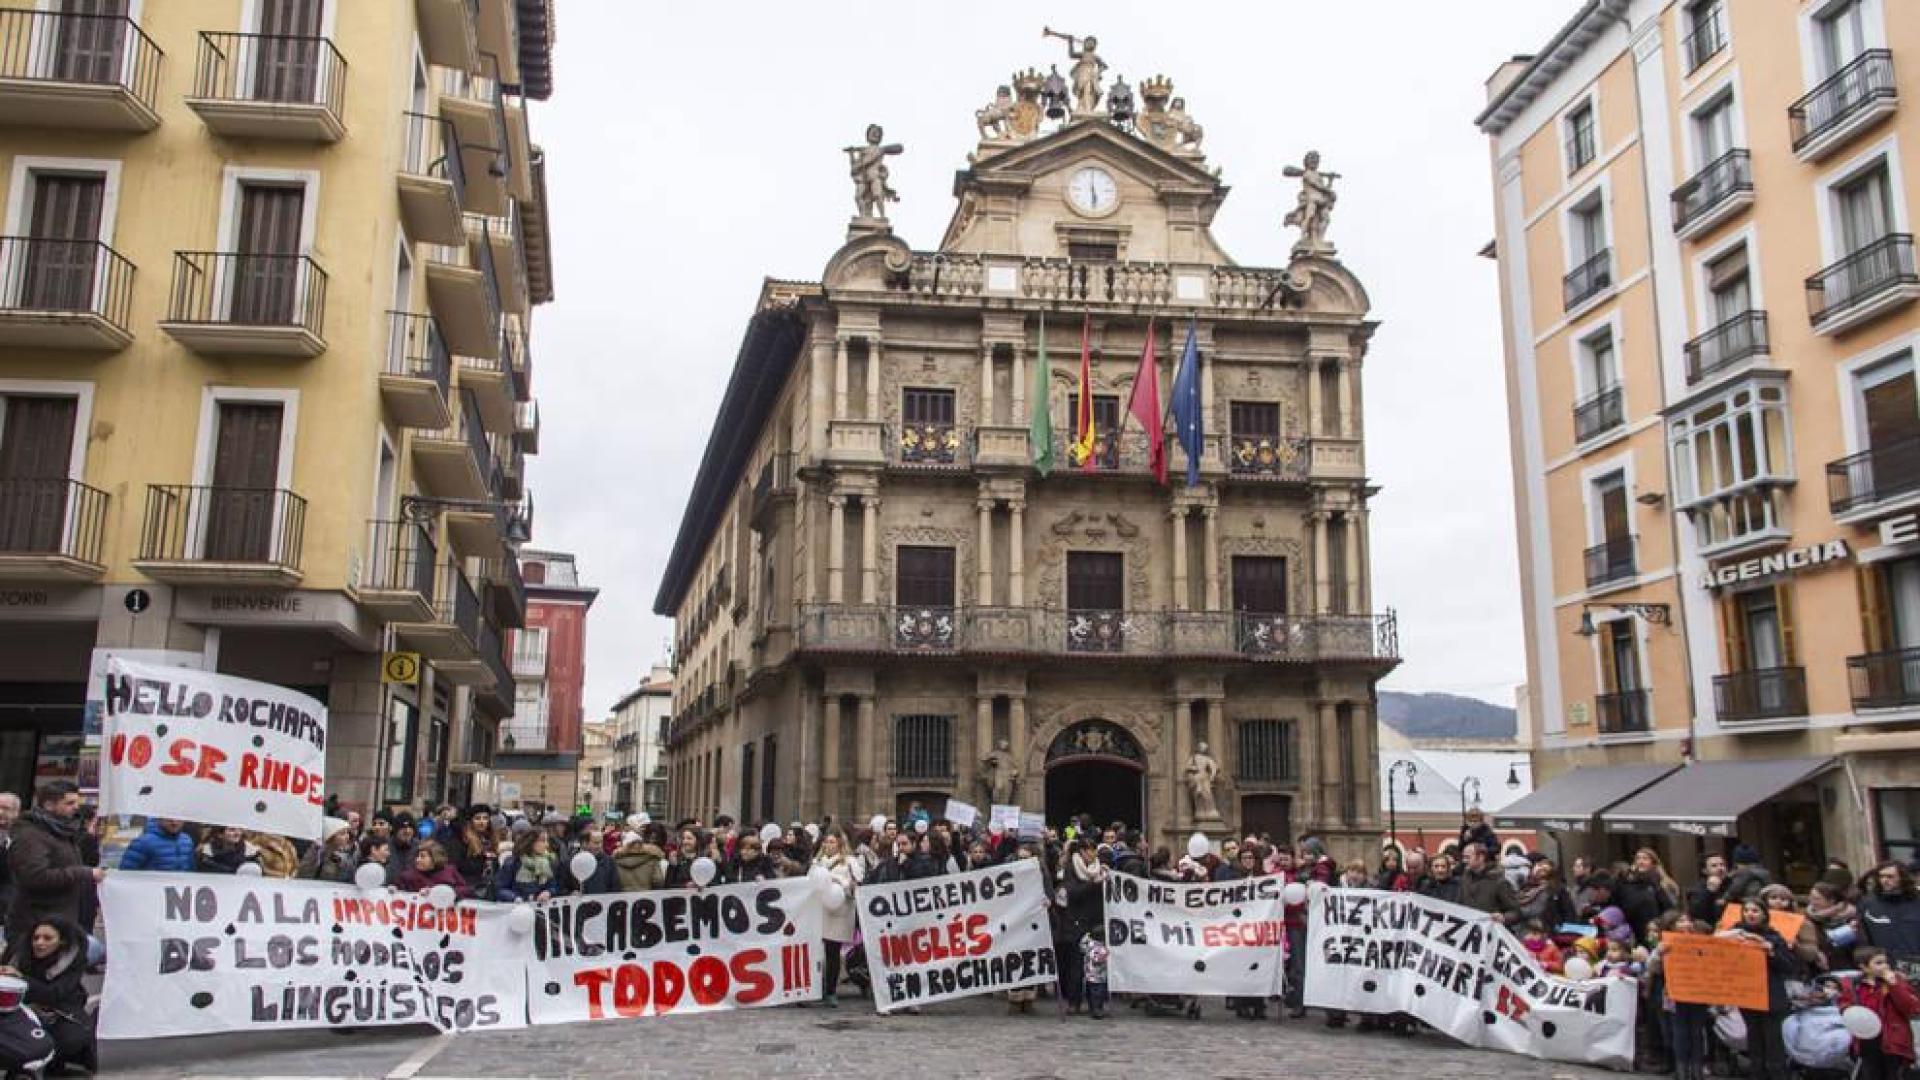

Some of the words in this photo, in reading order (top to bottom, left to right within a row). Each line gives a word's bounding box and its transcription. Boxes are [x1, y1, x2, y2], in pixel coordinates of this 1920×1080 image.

[1702, 538, 1848, 590] AGENCIA
[211, 594, 304, 612] BIENVENUE
[105, 673, 214, 719] HELLO
[159, 738, 228, 784] SE
[238, 753, 324, 806] RINDE
[164, 886, 218, 922] NO
[236, 891, 264, 923] A
[273, 893, 322, 924] LA
[868, 871, 1015, 917] QUEREMOS
[1105, 876, 1140, 905] NO
[1148, 883, 1177, 904] ME
[1108, 918, 1148, 946] DE
[158, 936, 221, 974] DE
[233, 934, 320, 969] LOS
[573, 931, 813, 1020] TODOS!!!
[886, 972, 922, 1001] EN
